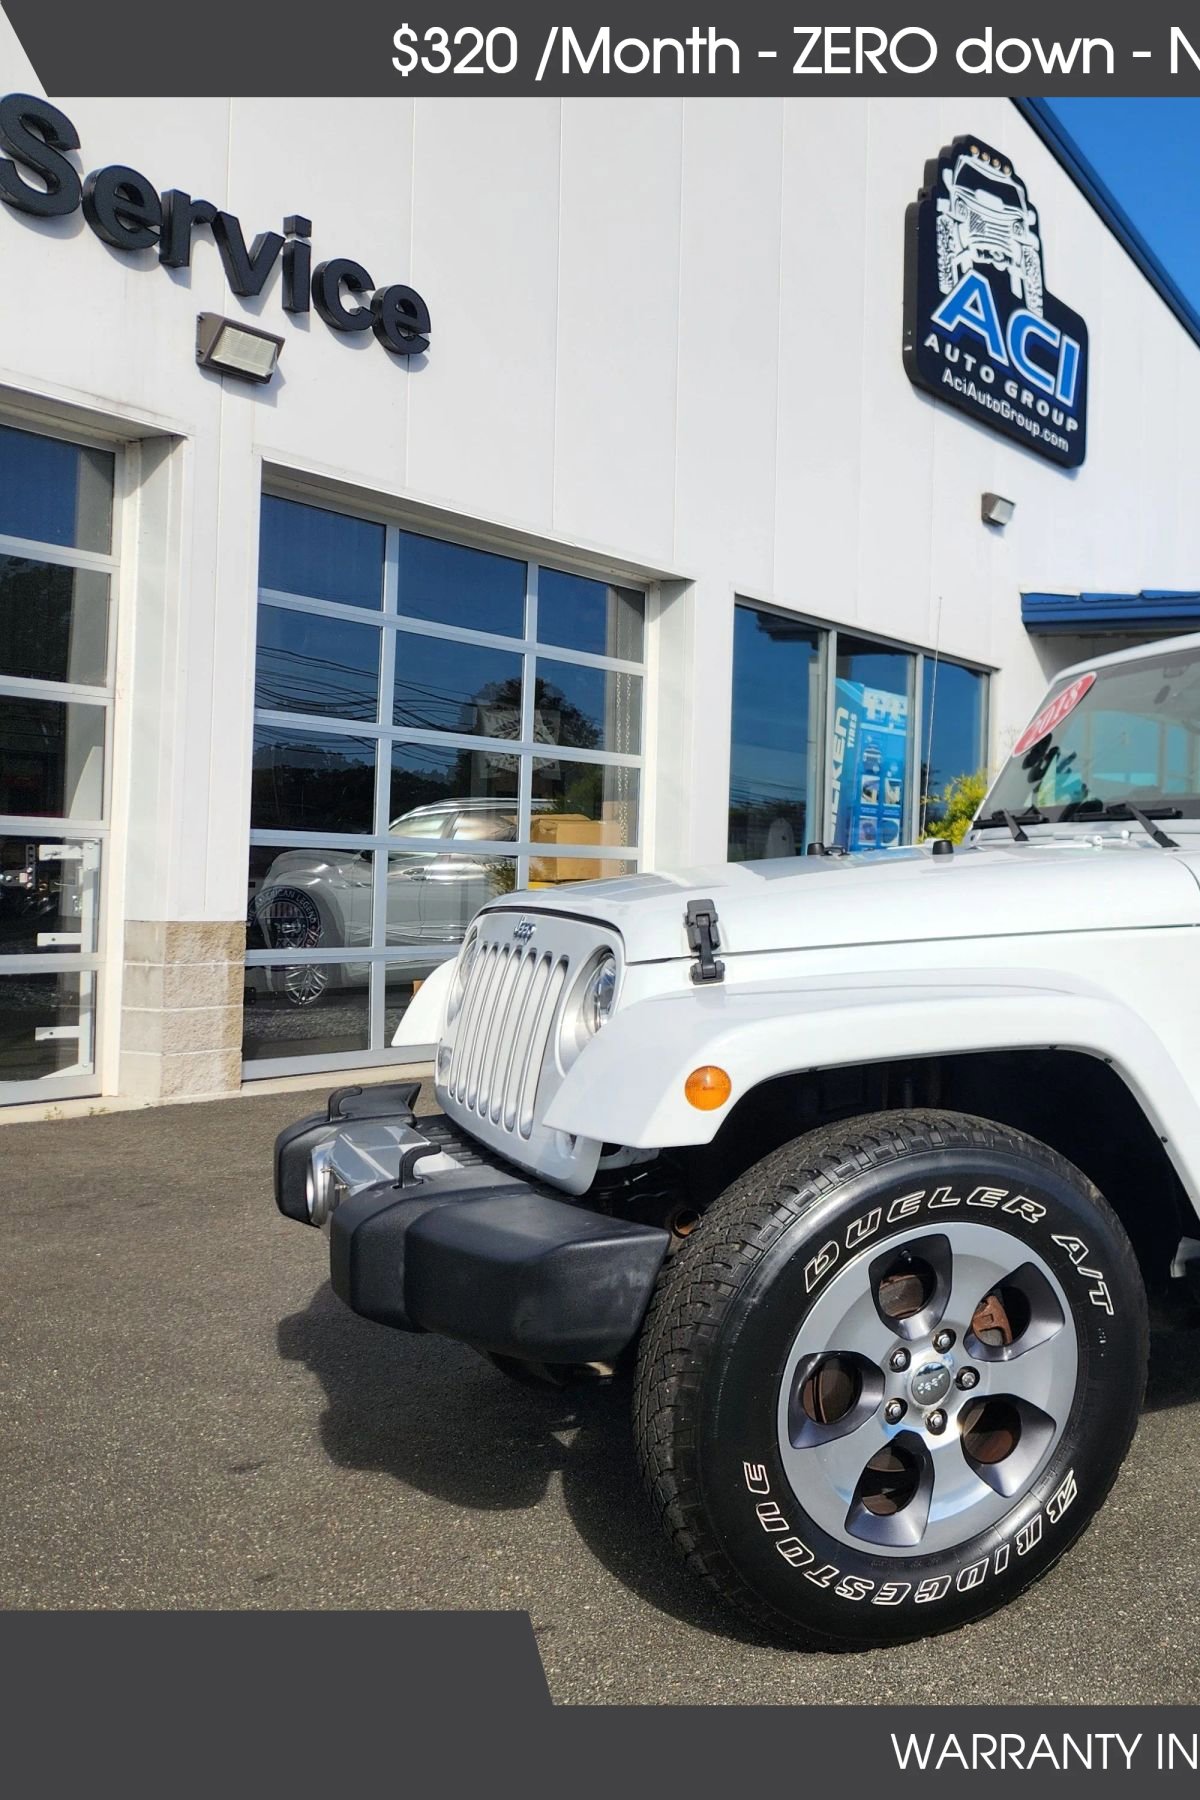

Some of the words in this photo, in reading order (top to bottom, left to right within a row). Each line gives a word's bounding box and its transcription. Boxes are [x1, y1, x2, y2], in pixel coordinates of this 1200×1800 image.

[0, 93, 432, 355] Service
[924, 333, 995, 384] AUTO
[1004, 379, 1079, 432] GROUP
[931, 269, 1080, 408] ACI
[941, 366, 1069, 452] AciAutoGroup.com
[805, 1186, 1048, 1294] DUELER
[1051, 1233, 1115, 1316] A/T
[743, 1461, 1079, 1606] BRIDGESTONE
